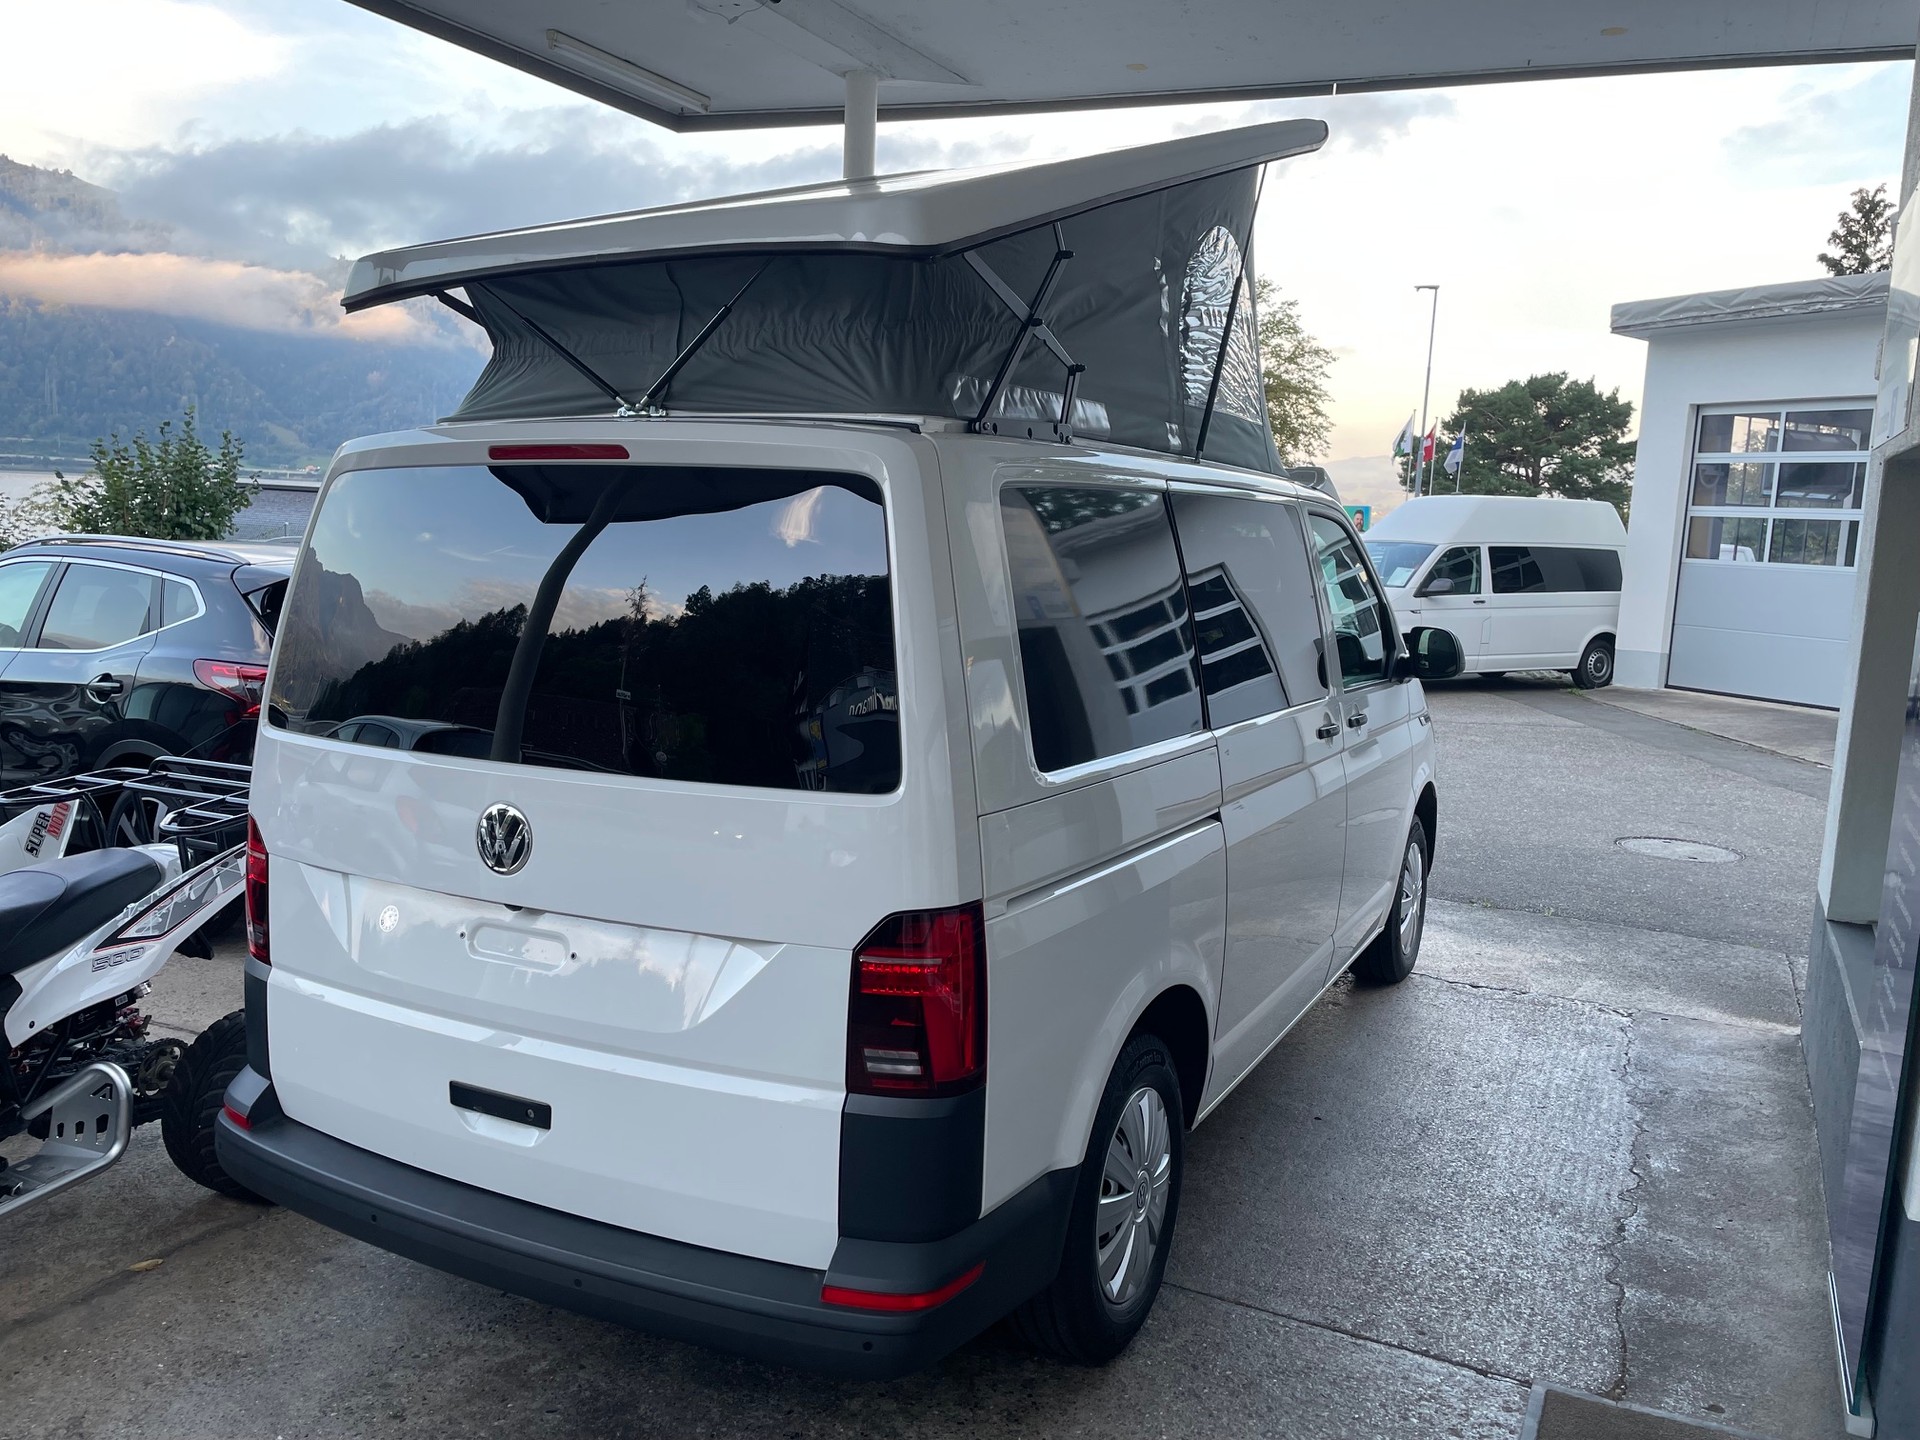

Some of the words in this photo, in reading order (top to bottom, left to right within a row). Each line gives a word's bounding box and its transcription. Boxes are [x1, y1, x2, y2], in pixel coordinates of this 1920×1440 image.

[24, 811, 51, 859] SUPER
[477, 801, 533, 875] VW
[91, 946, 145, 973] 500
